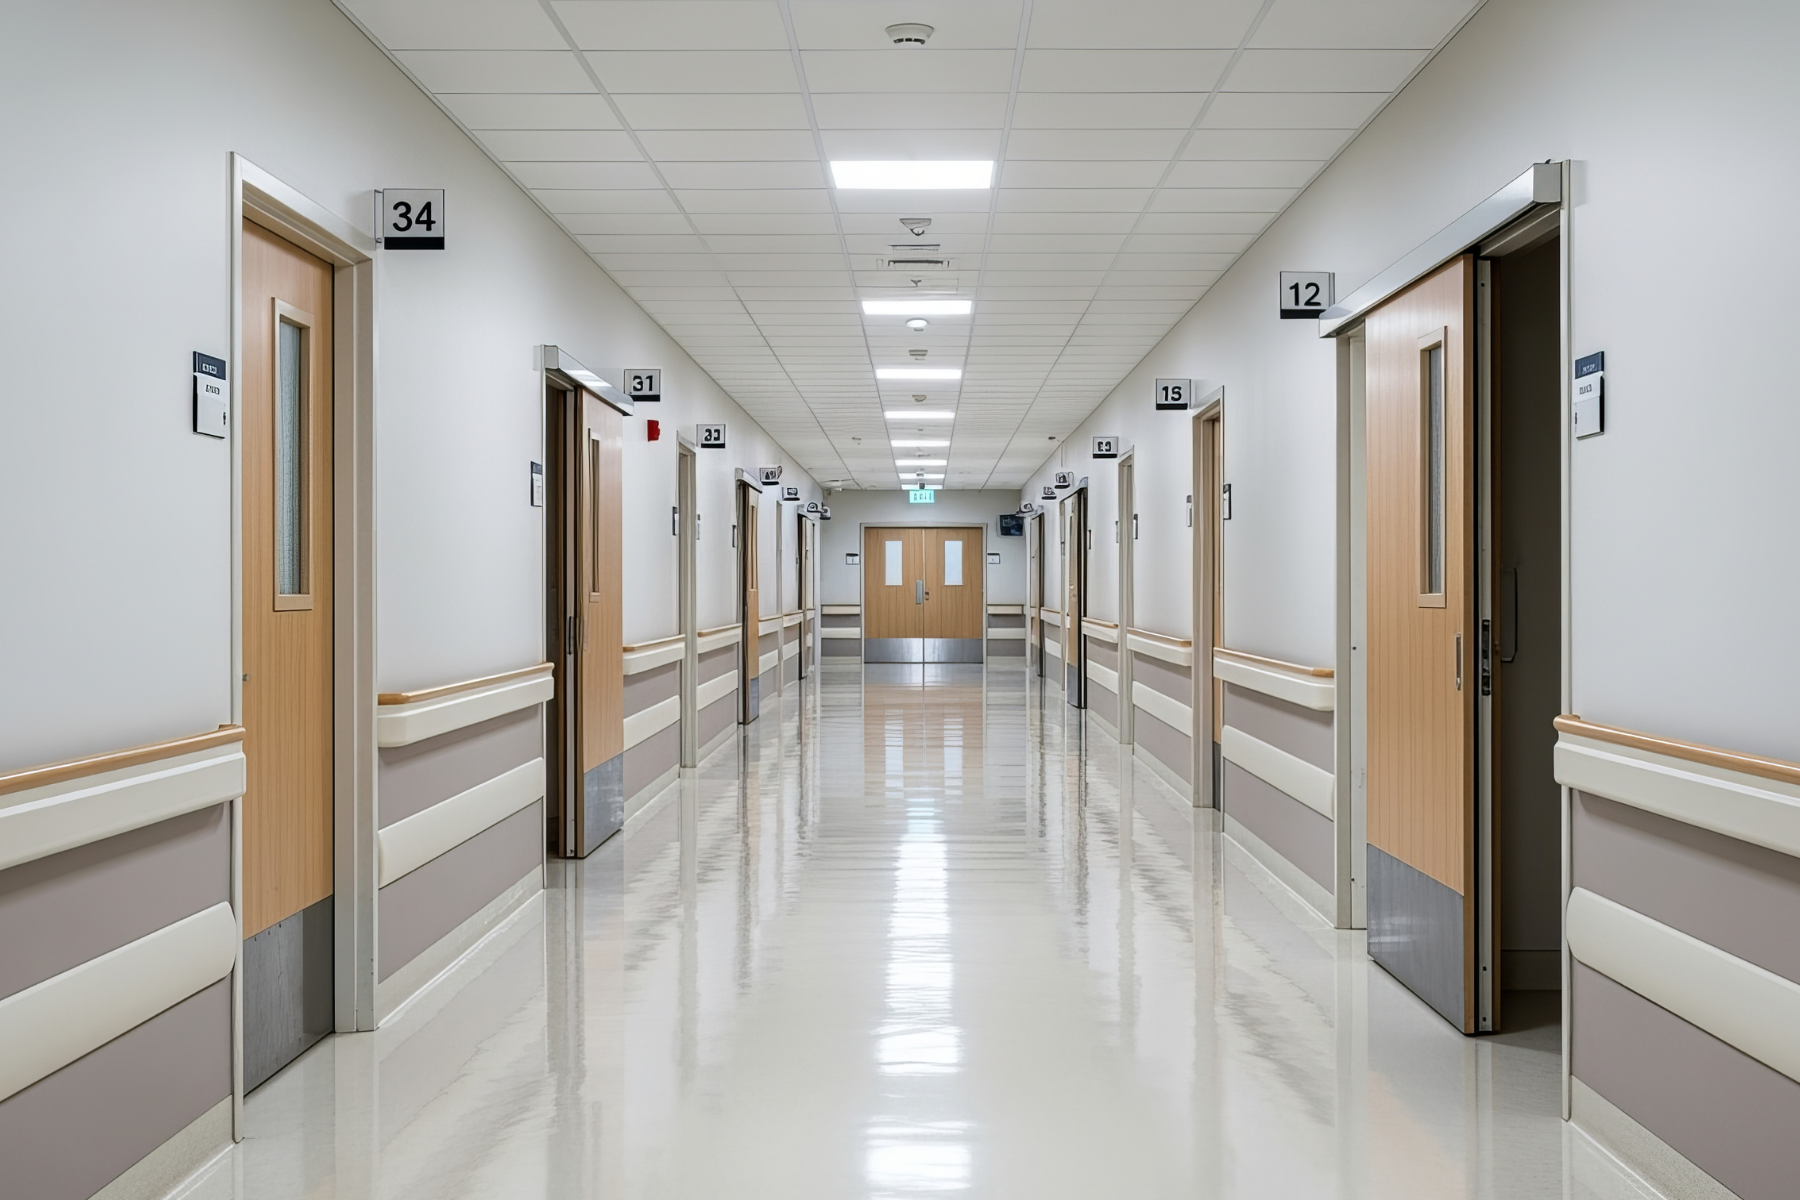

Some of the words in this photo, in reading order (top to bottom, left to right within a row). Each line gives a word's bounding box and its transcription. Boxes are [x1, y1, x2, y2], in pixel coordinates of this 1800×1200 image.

[392, 201, 436, 232] 34
[1289, 282, 1322, 307] 12
[632, 374, 653, 392] 31
